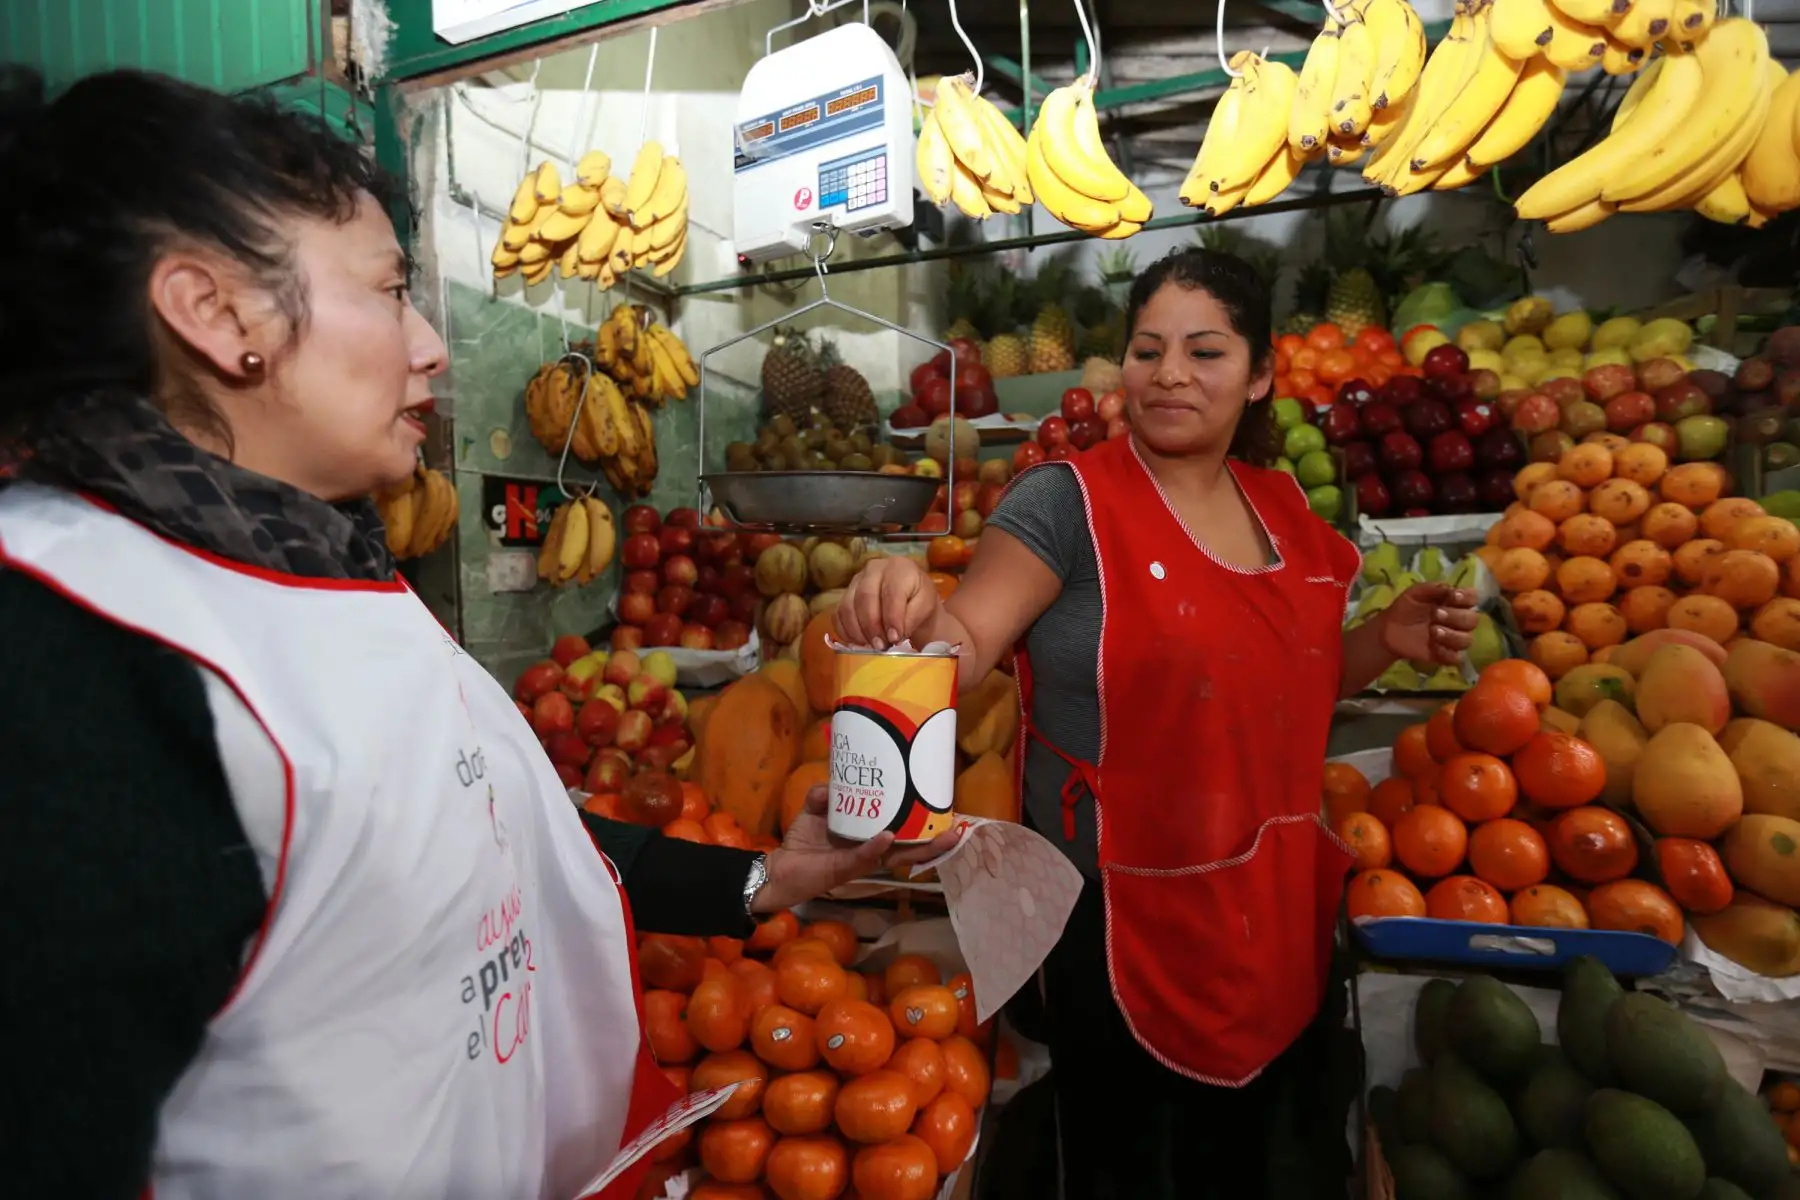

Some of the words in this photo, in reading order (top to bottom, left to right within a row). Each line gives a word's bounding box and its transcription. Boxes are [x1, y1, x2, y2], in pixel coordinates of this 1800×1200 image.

[832, 732, 850, 751] IGA
[835, 792, 881, 819] 2018
[467, 1014, 488, 1060] el
